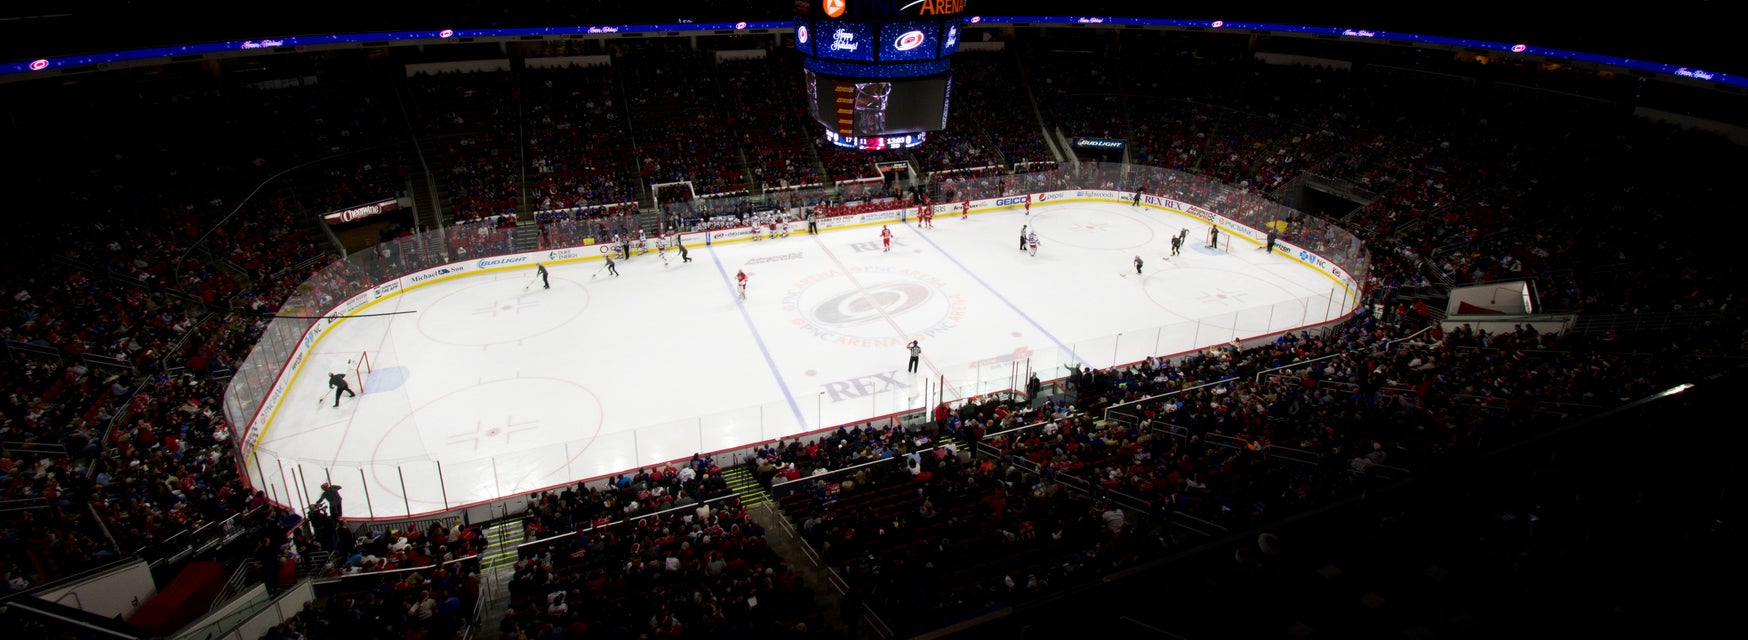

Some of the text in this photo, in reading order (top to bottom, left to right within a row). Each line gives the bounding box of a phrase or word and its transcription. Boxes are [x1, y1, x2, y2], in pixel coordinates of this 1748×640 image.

[833, 28, 854, 41] Happy
[830, 39, 858, 52] Holidays!
[996, 196, 1027, 207] GEICO
[1145, 195, 1163, 206] REX
[1165, 199, 1182, 211] REX
[343, 204, 379, 222] Cheerwine
[480, 255, 527, 267] BUD LIGHT
[1315, 258, 1327, 269] NC
[411, 265, 464, 283] Michael Son
[832, 335, 903, 349] ARENA
[820, 370, 912, 403] REX
